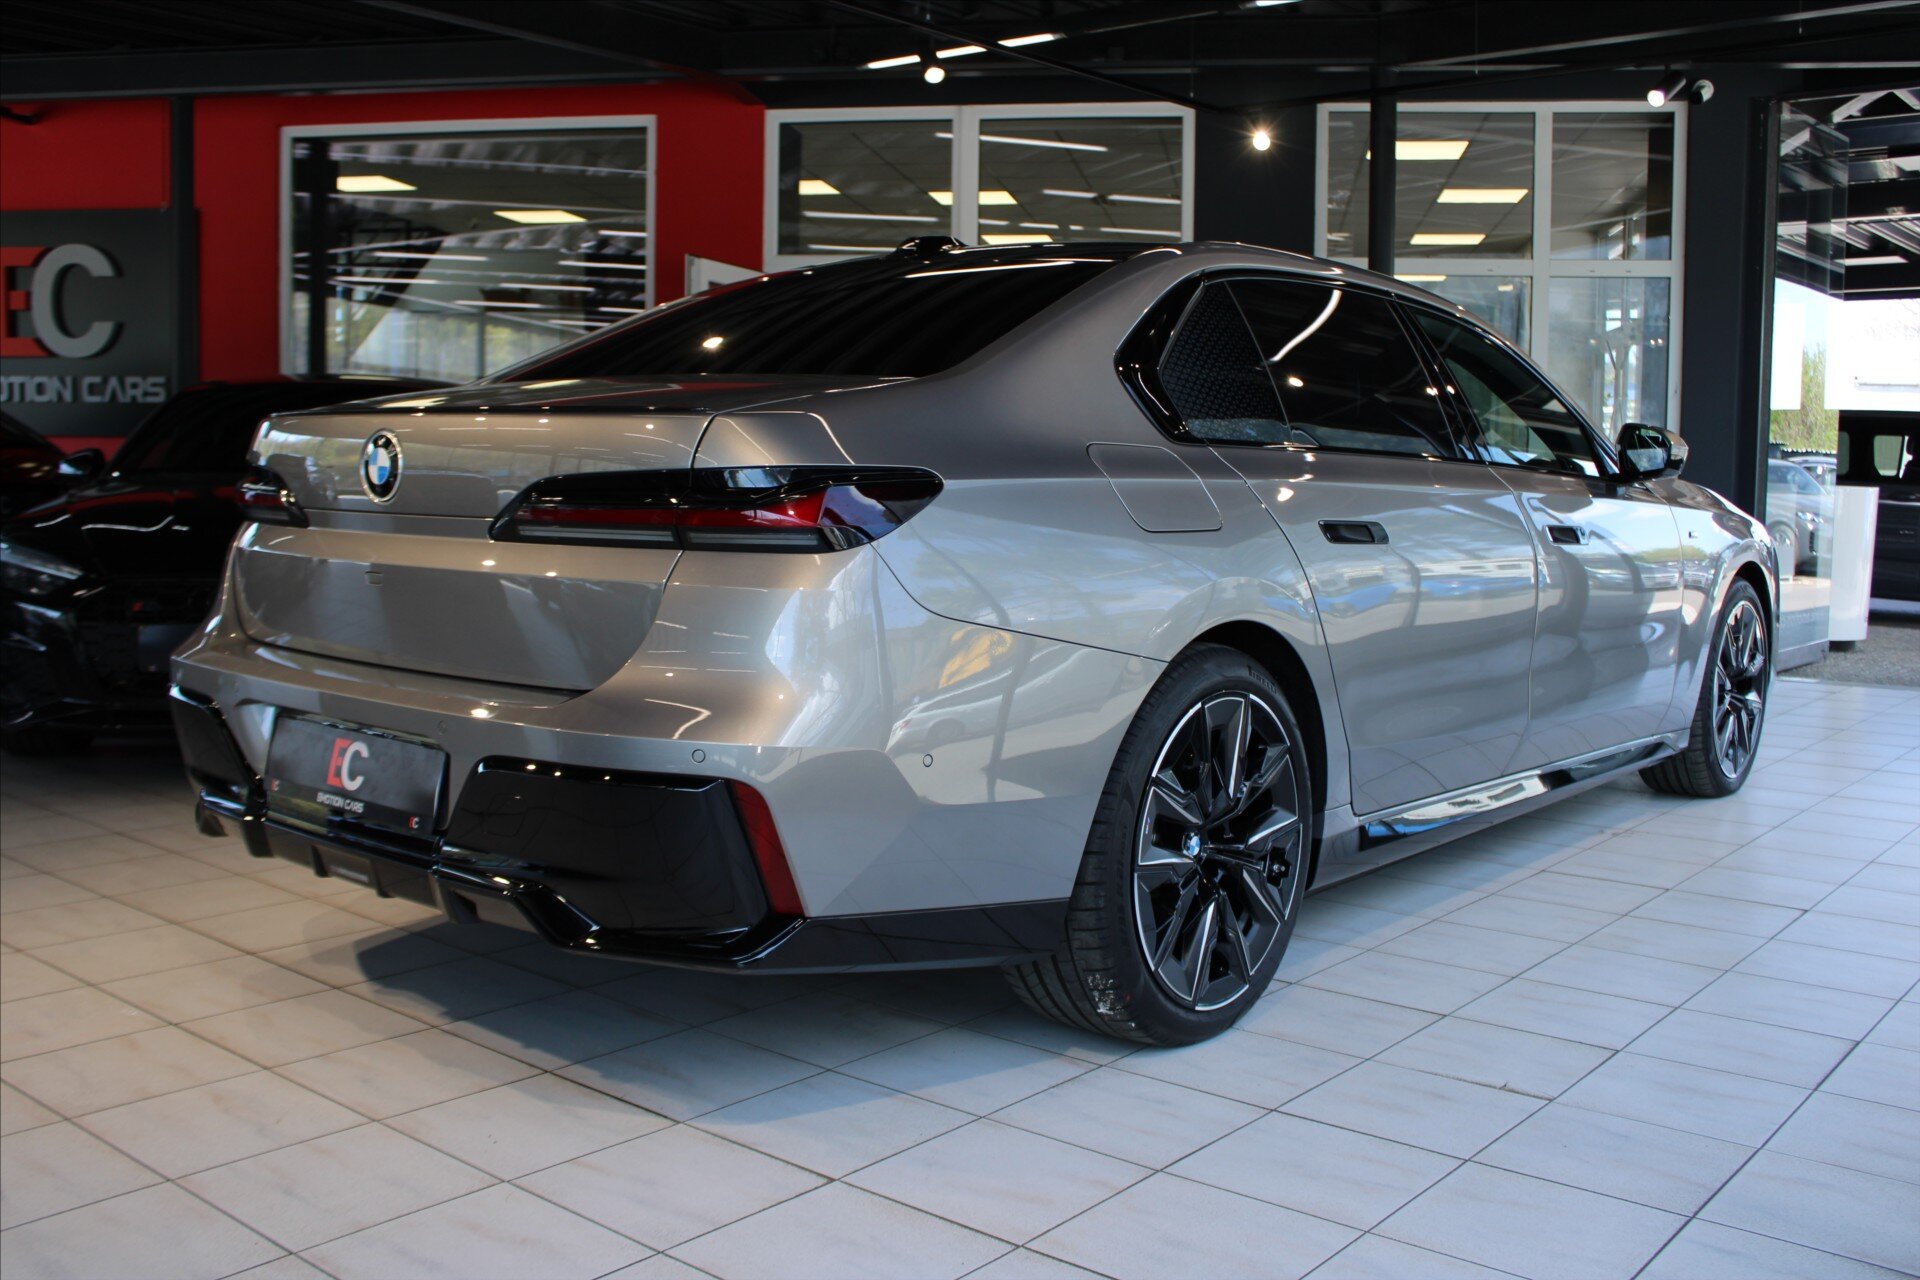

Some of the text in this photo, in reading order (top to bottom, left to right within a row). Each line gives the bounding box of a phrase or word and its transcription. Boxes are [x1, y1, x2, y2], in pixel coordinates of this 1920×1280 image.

[0, 243, 116, 359] EC
[81, 376, 167, 403] CARS
[326, 738, 370, 791] EC
[344, 799, 365, 813] CARS
